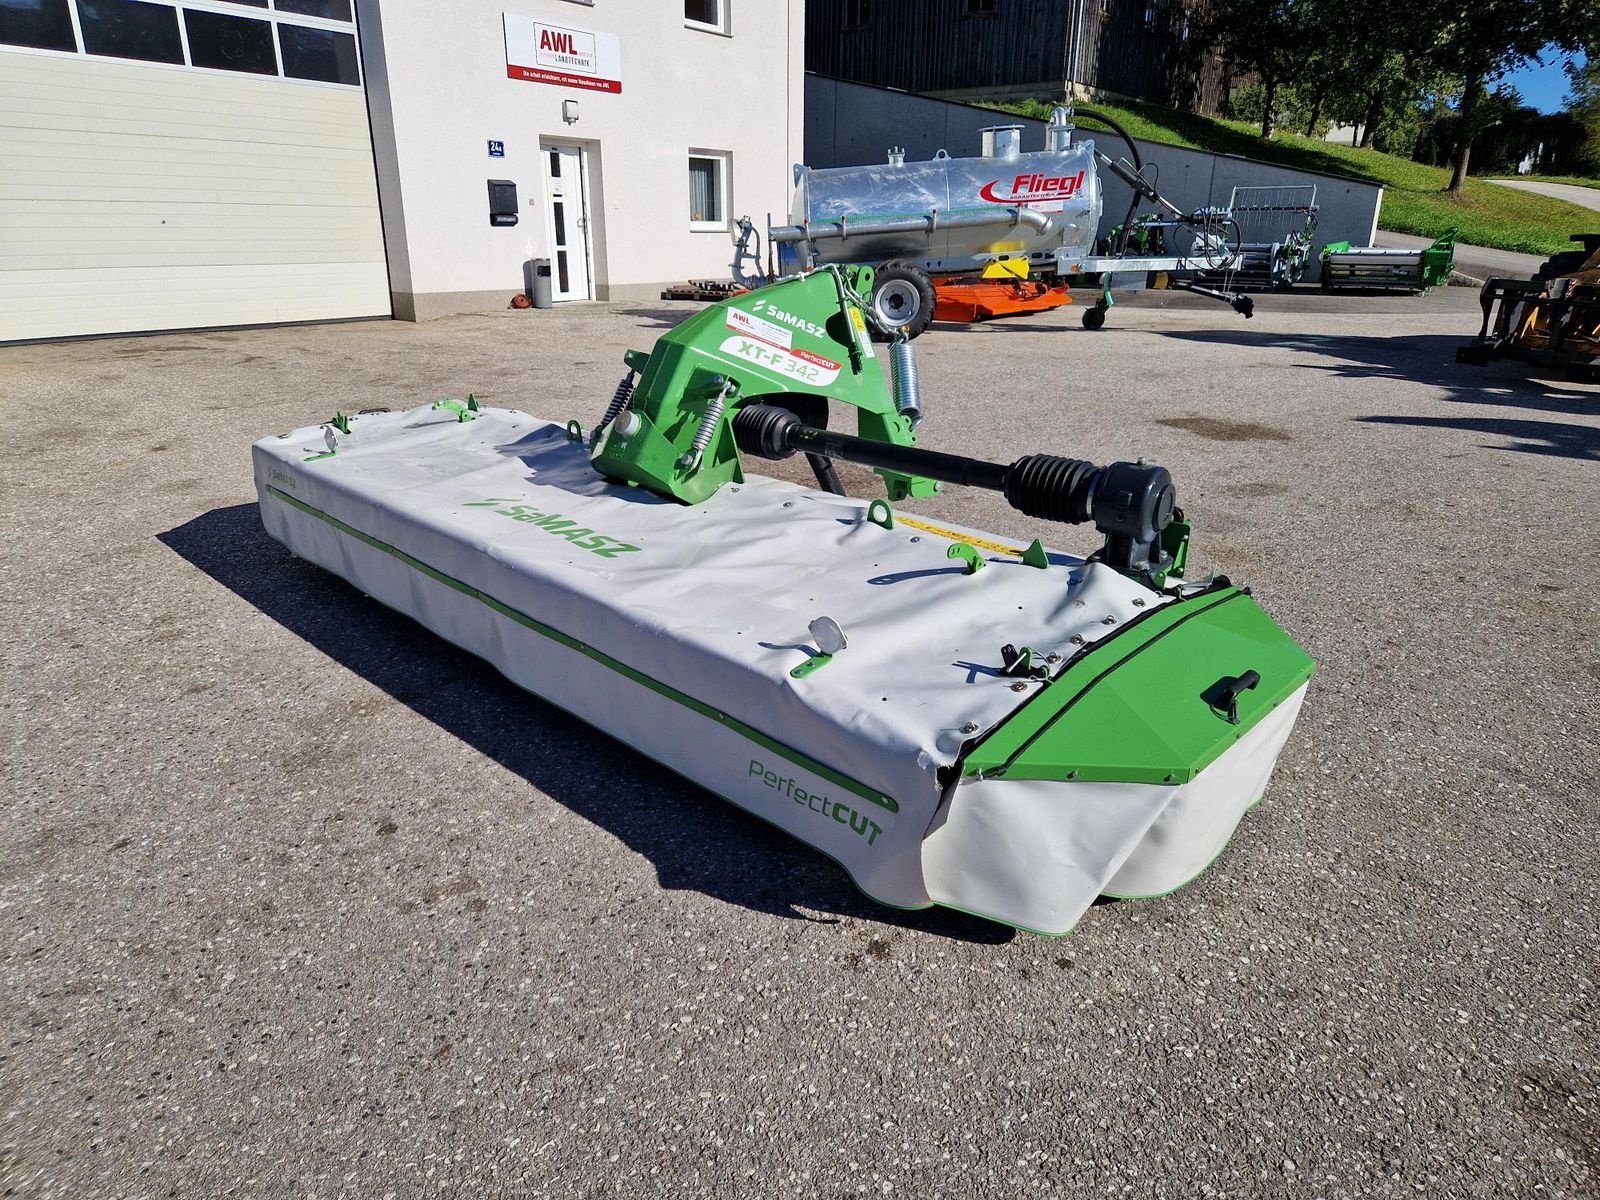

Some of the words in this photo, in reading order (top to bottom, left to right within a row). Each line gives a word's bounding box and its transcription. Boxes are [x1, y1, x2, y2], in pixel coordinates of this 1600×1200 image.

[540, 29, 578, 55] AWL
[1011, 170, 1086, 195] Fliegl
[732, 312, 751, 325] AWL
[767, 304, 826, 338] SaMASZ
[737, 341, 784, 365] XT-F
[784, 358, 820, 382] 342
[800, 350, 836, 369] PerfectCUT
[494, 504, 643, 558] SaMASZ
[748, 759, 884, 847] PerfectCUT
